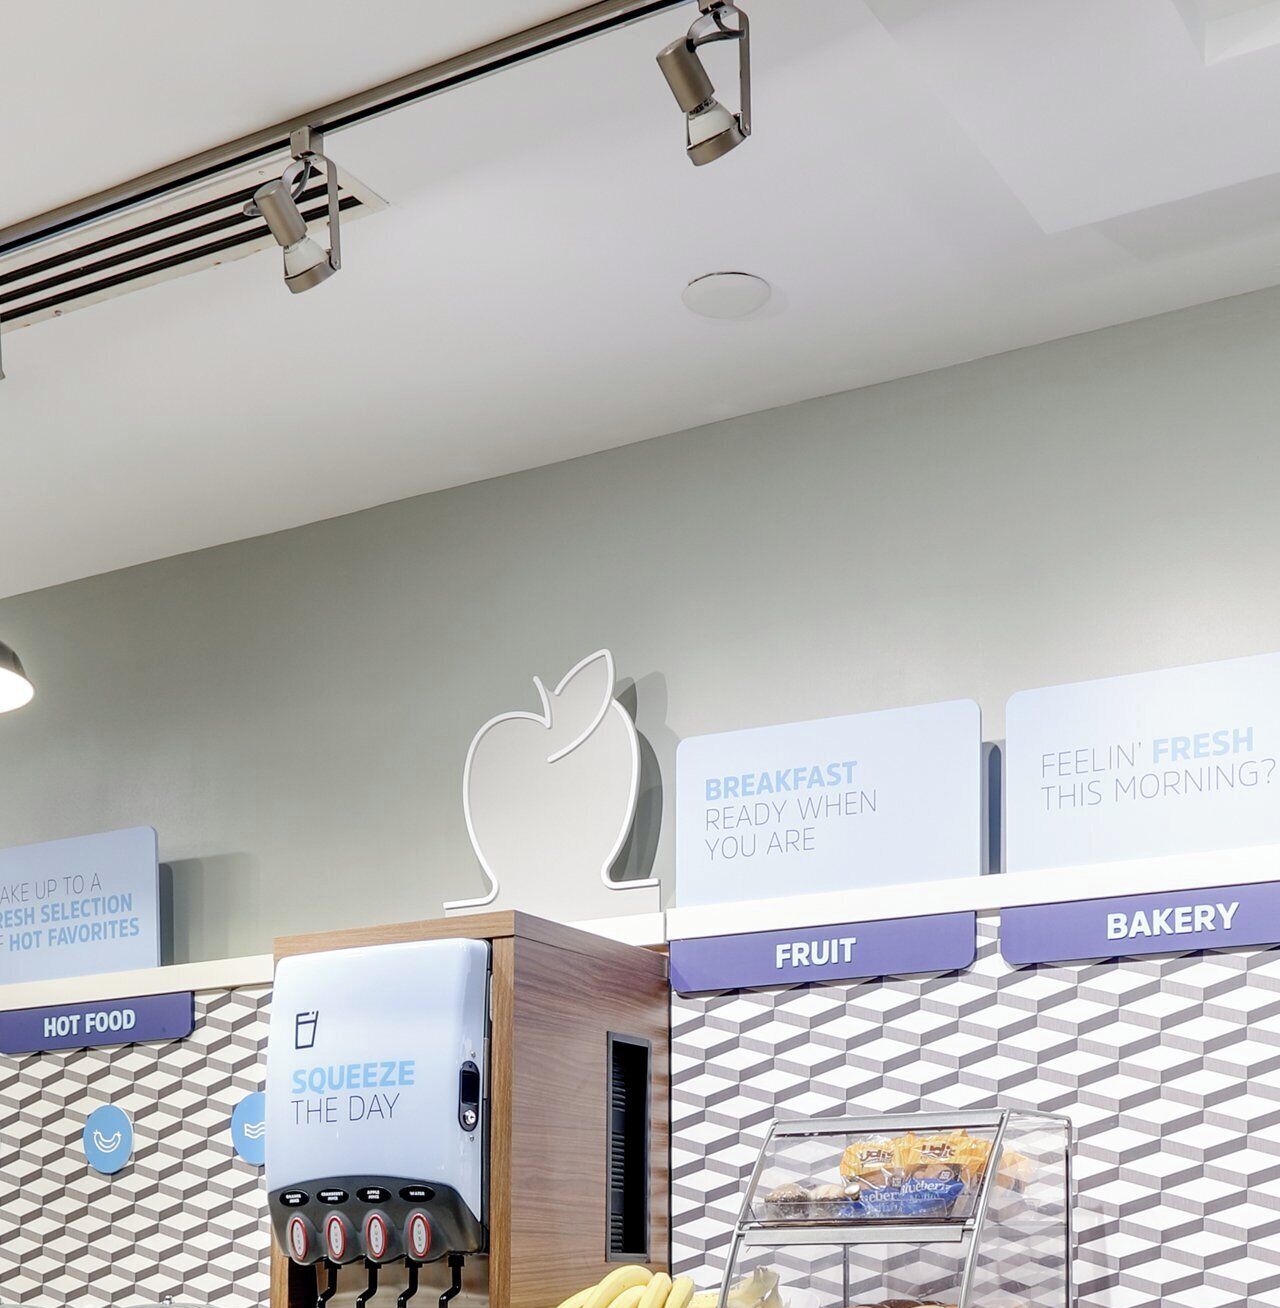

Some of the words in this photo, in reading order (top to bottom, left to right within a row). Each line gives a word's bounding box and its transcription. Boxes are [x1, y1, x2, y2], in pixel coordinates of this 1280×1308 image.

[1152, 726, 1254, 764] FRESH
[705, 760, 858, 801] BREAKFAST
[1040, 780, 1102, 811] THIS
[1115, 758, 1276, 803] MORNING?
[706, 800, 787, 831] READY
[797, 789, 877, 821] WHEN
[705, 833, 756, 861] YOU
[766, 826, 816, 855] ARE
[35, 879, 57, 900] UP
[64, 874, 85, 896] TO
[90, 872, 102, 892] A
[40, 893, 132, 924] SELECTION
[1106, 901, 1240, 941] BAKERY
[9, 930, 43, 952] HOT
[48, 917, 140, 947] FAVORITES
[775, 937, 857, 969] FRUIT
[44, 1014, 80, 1038] HOT
[85, 1009, 136, 1034] FOOD
[292, 1060, 416, 1095] SQUEEZE
[291, 1097, 338, 1125] THE
[349, 1093, 400, 1121] DAY
